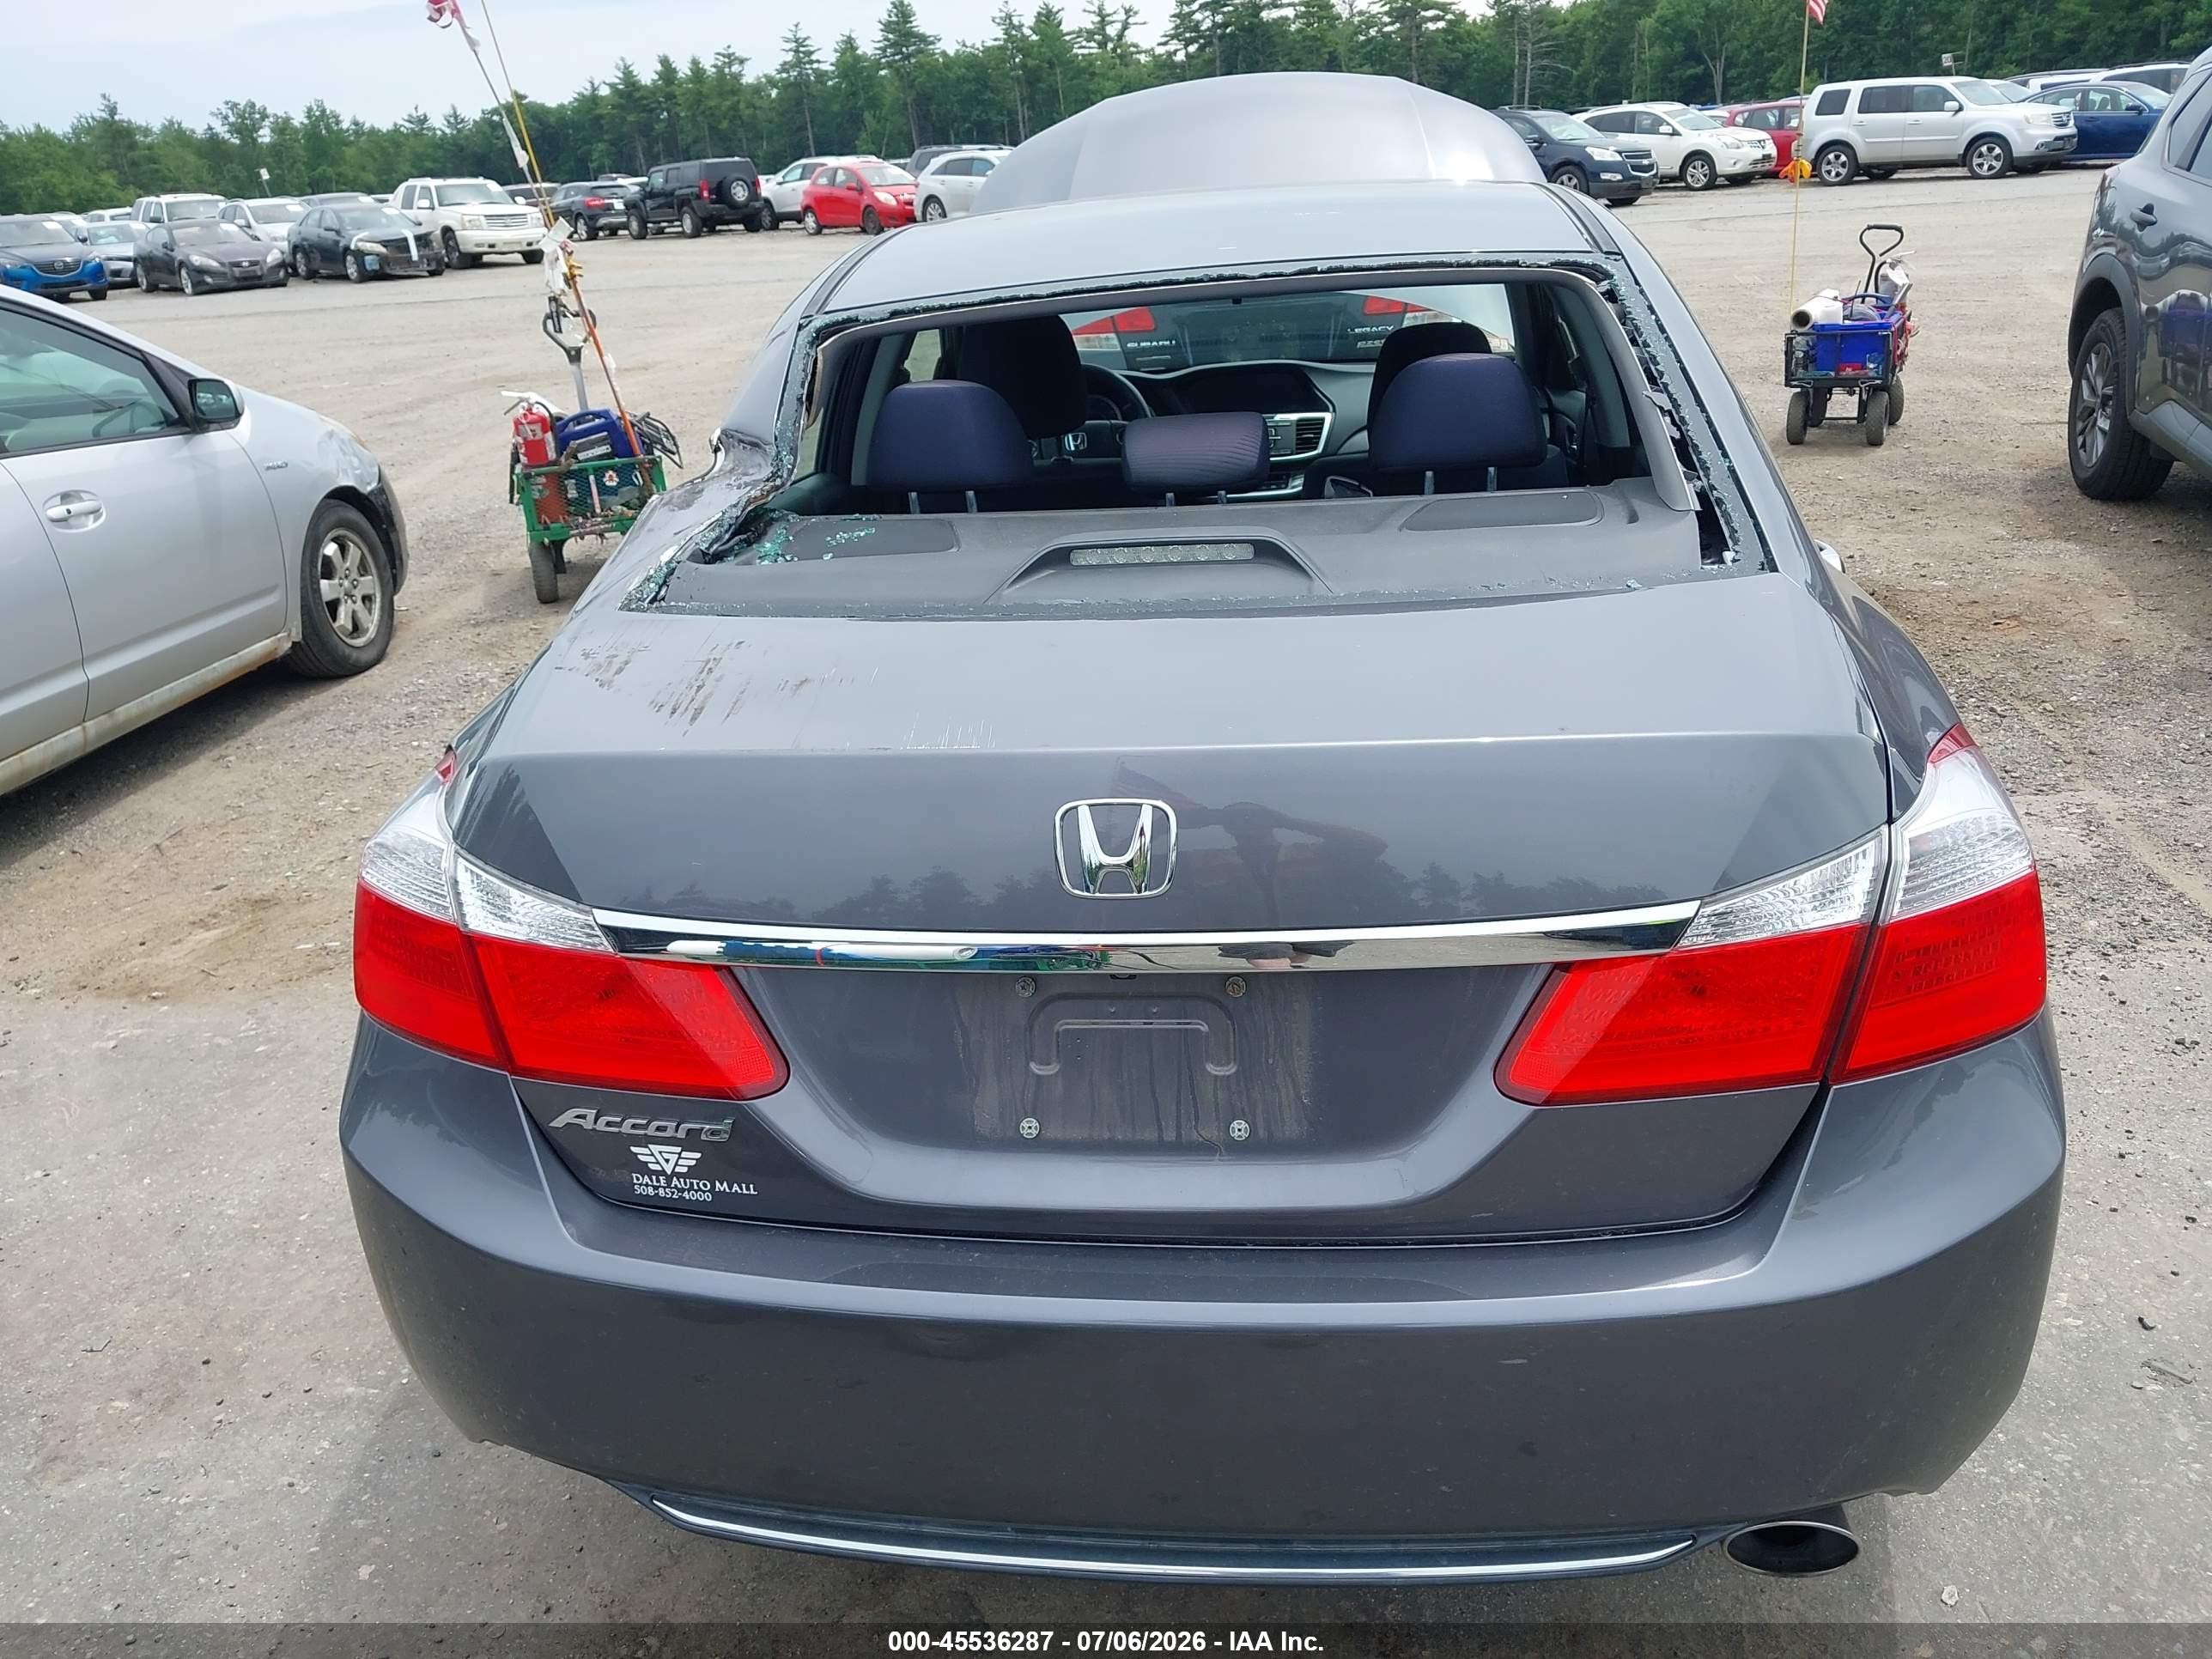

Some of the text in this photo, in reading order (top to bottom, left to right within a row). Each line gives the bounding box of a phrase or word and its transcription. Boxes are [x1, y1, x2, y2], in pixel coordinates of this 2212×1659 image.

[1346, 325, 1395, 335] LEGACY
[549, 1106, 736, 1142] Accord
[631, 1173, 758, 1195] DALE AUTO MALL
[634, 1184, 713, 1202] 508-852-4000
